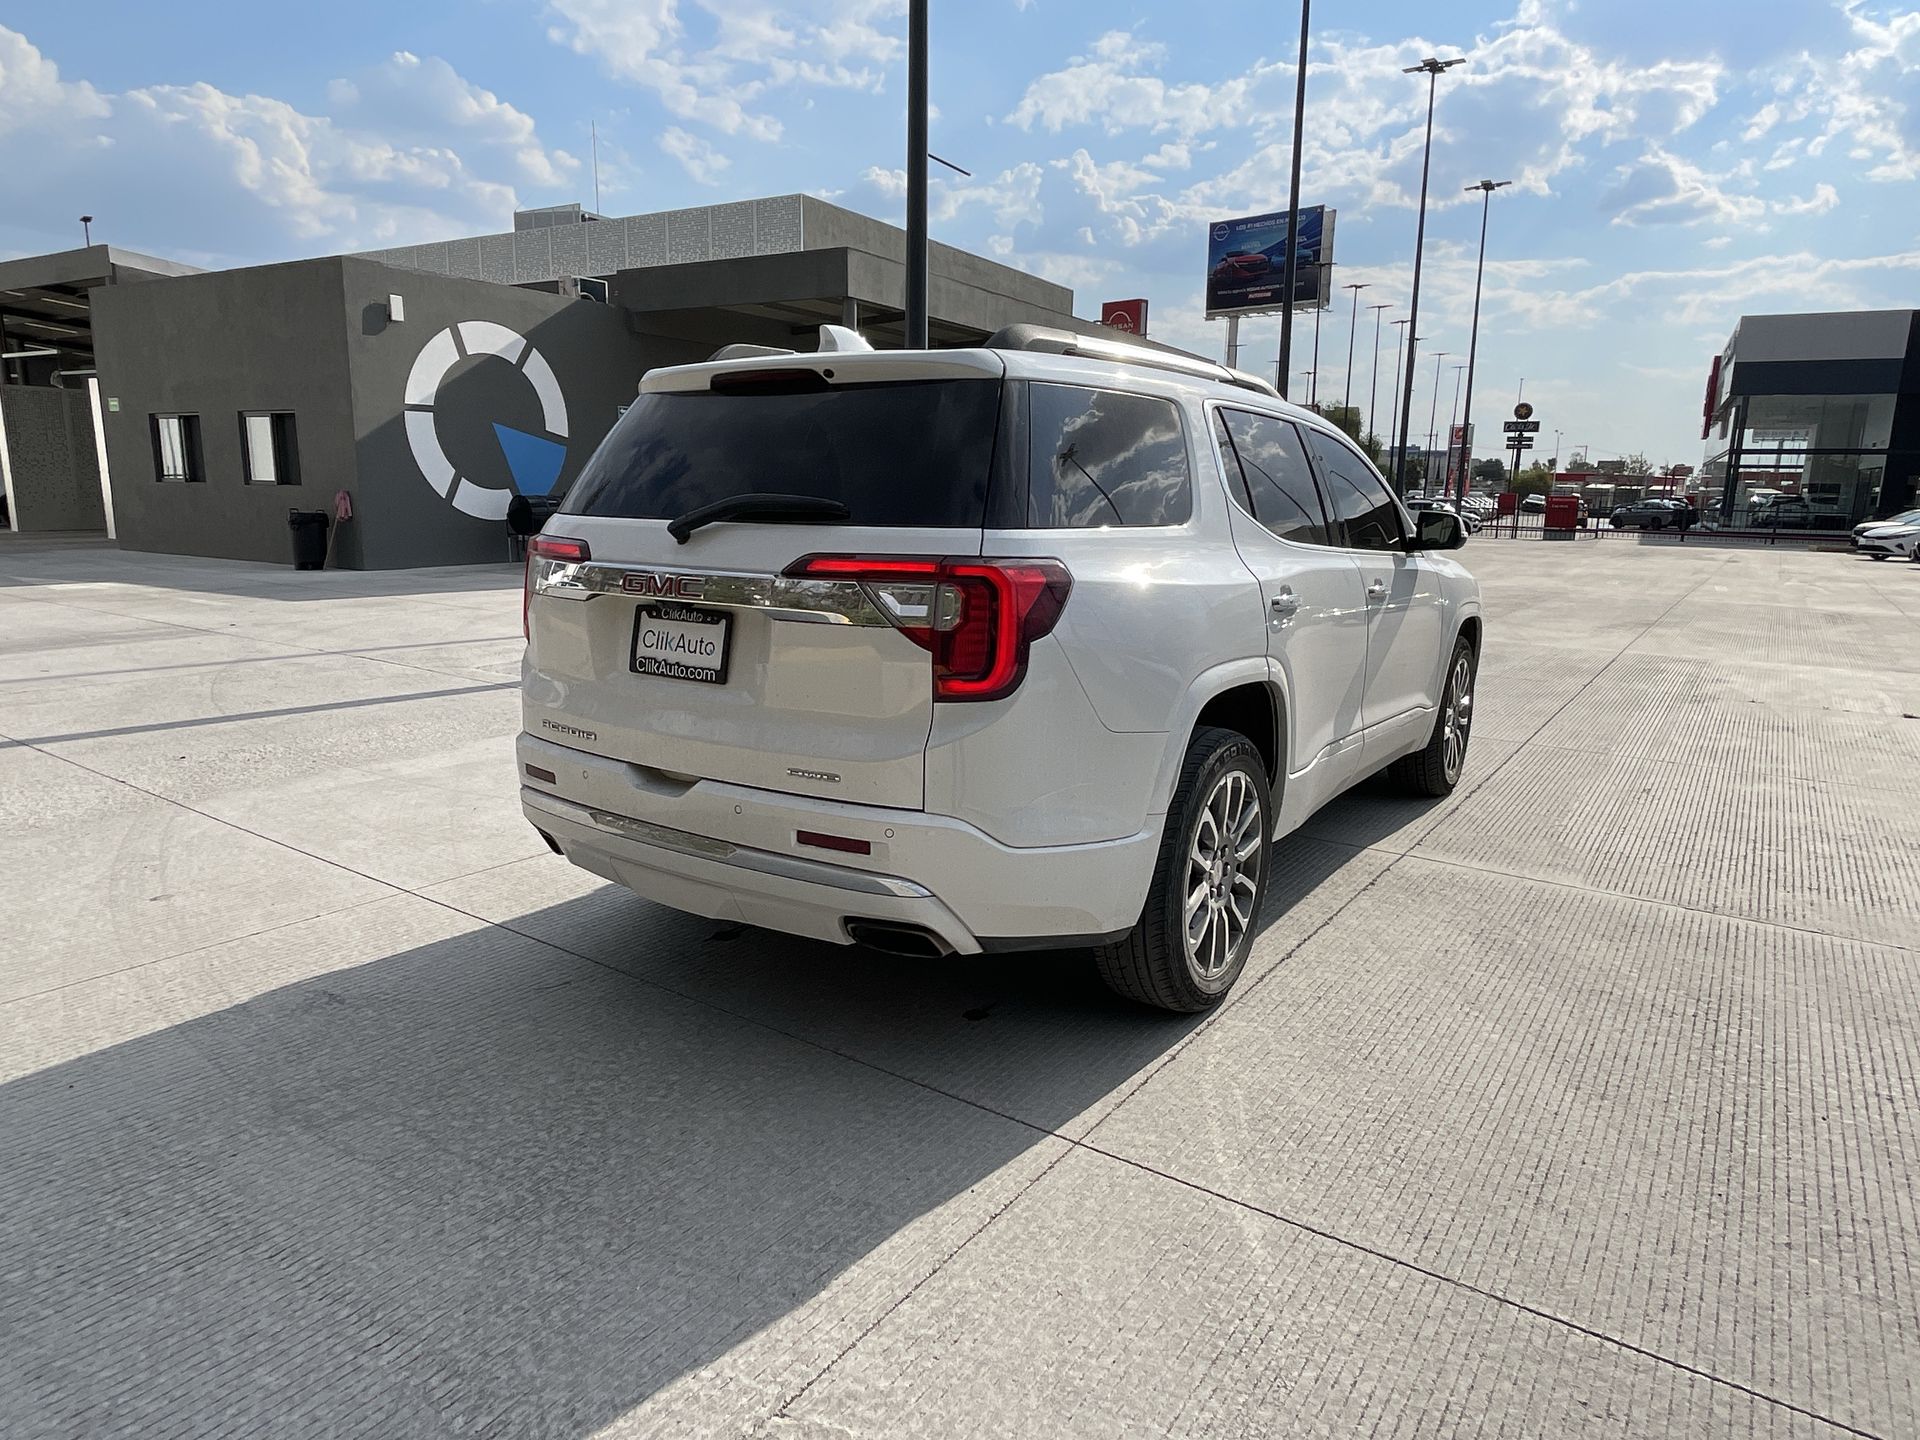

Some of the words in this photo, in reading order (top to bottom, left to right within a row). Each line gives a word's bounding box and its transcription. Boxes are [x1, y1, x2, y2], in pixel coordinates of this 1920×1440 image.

[622, 572, 705, 599] GMC
[661, 608, 704, 622] ClikAuto
[642, 629, 716, 656] ClikAuto
[636, 657, 717, 681] ClikAuto.com
